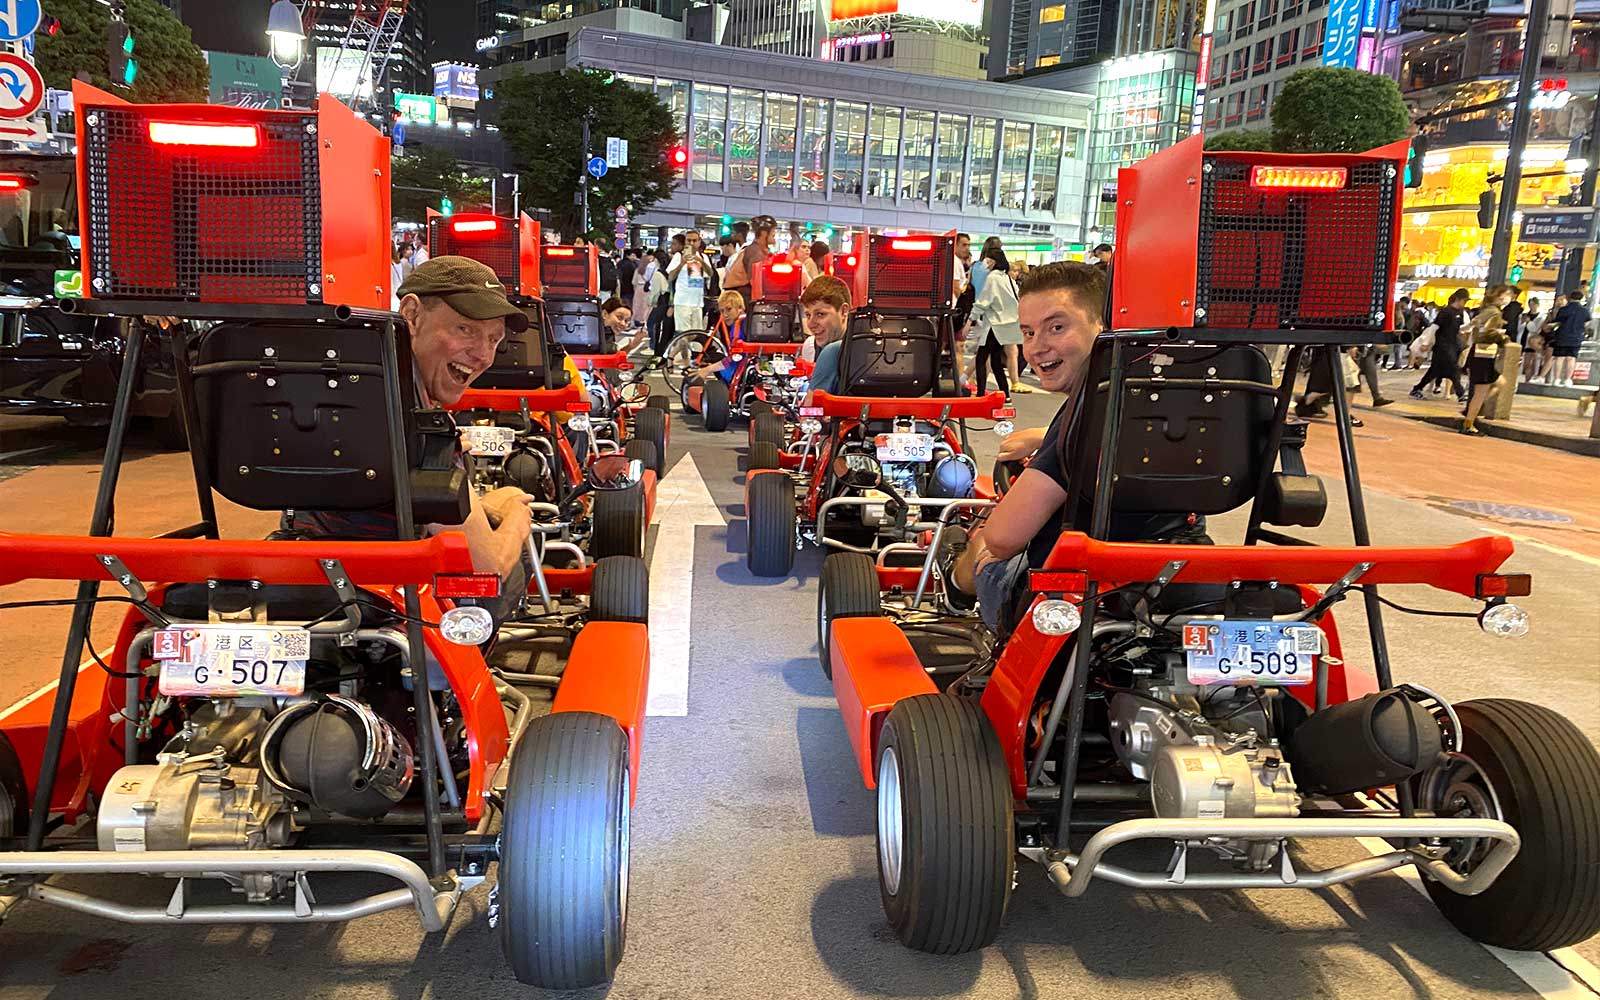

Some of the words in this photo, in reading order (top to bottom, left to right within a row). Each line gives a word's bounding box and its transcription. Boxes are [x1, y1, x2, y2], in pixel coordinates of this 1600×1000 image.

[476, 36, 499, 50] GMO
[1326, 0, 1347, 66] イシ
[1344, 0, 1360, 67] タク
